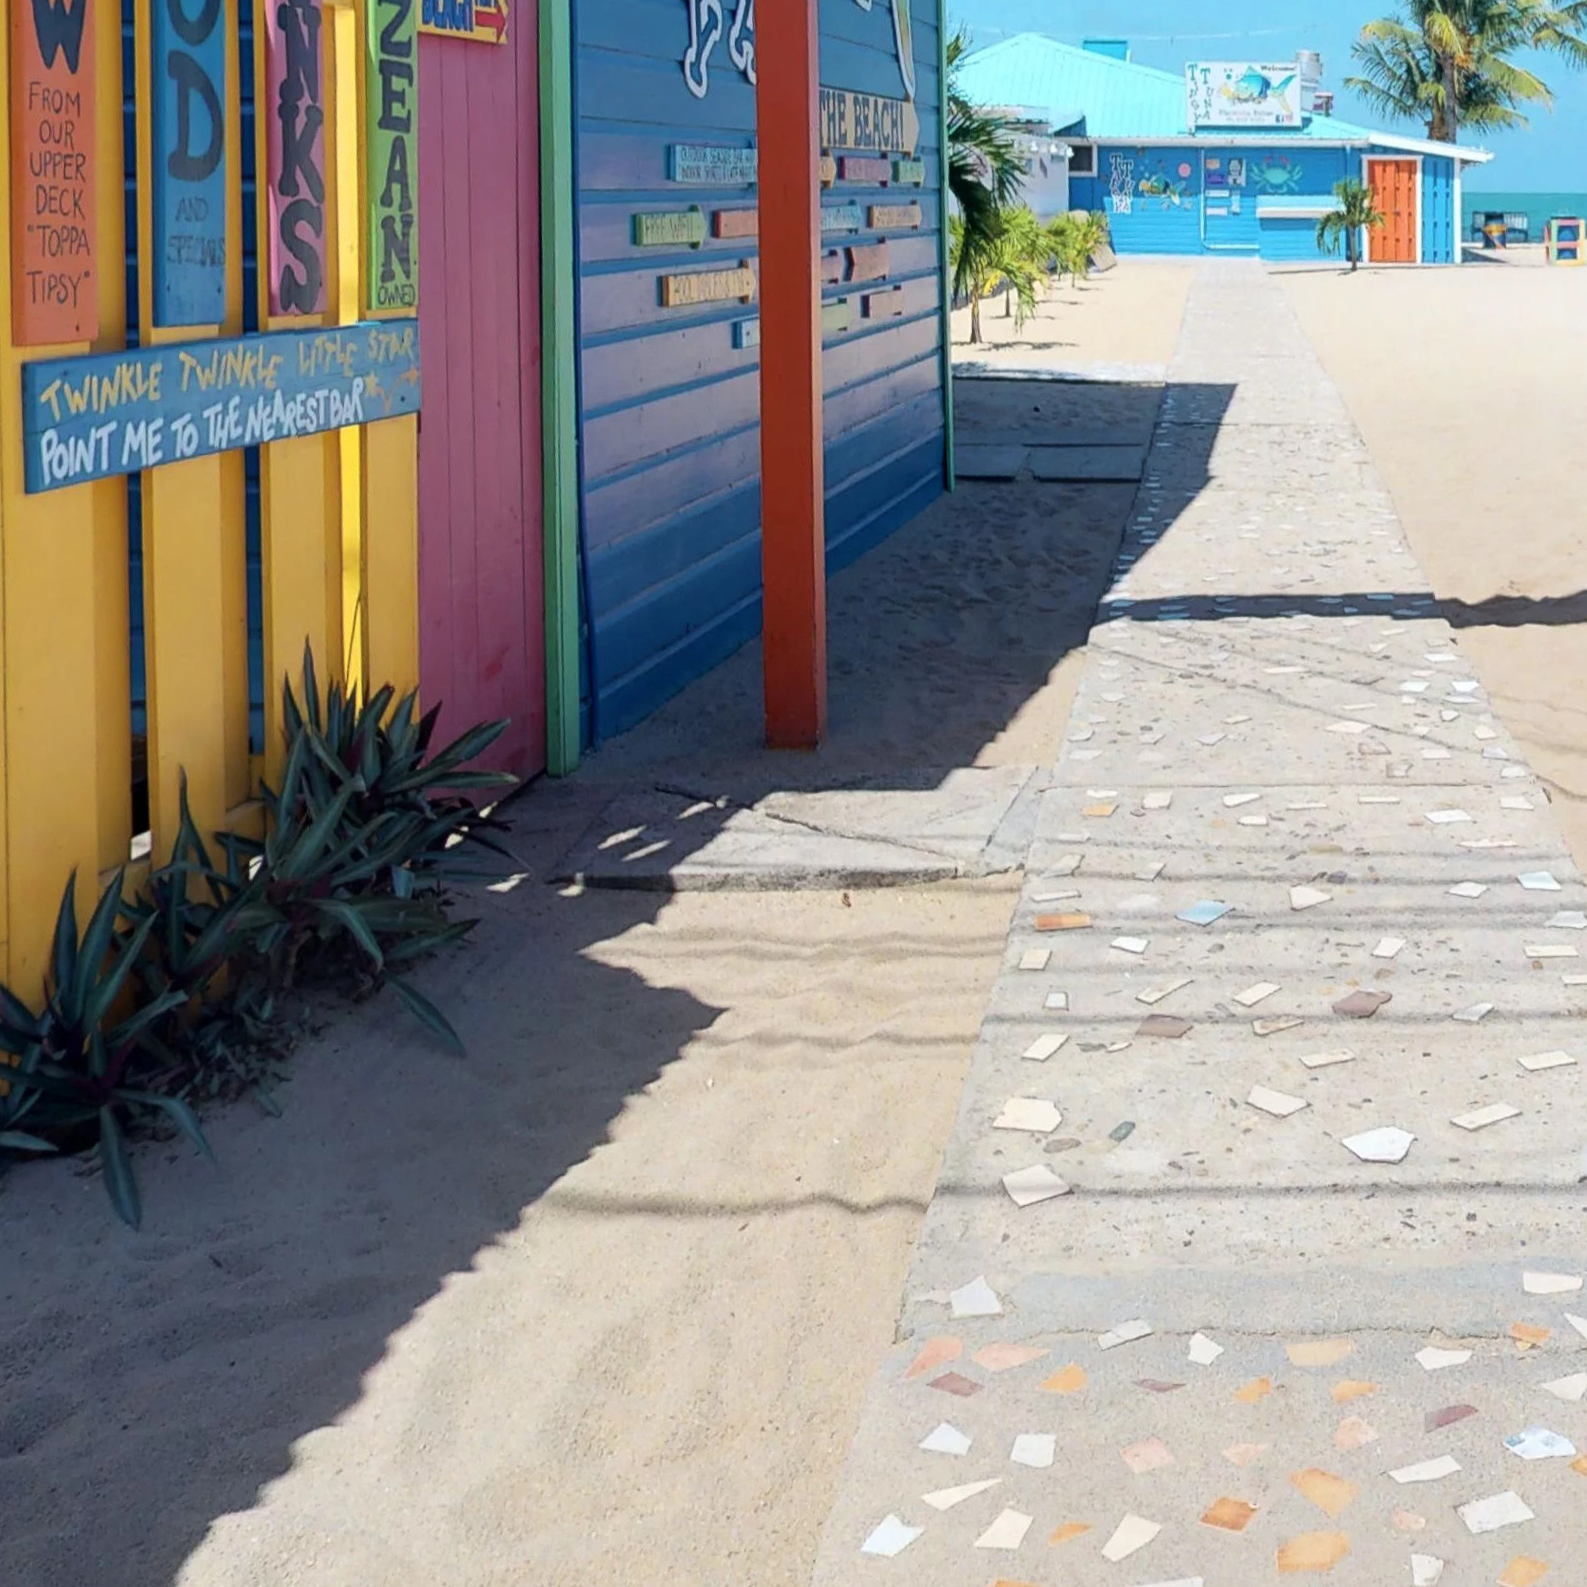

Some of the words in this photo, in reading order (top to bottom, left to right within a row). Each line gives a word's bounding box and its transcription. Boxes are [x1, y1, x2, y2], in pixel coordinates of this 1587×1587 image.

[28, 81, 82, 118] FROM
[38, 120, 76, 151] OUR
[820, 88, 849, 147] THE
[853, 96, 906, 150] BEACH!
[29, 151, 87, 184] UPPER
[35, 185, 85, 217] DECK
[174, 195, 210, 223] AND
[376, 283, 416, 306] OWNED
[40, 362, 163, 422] TWINKLE
[178, 344, 285, 392] TWINKLE
[298, 333, 358, 378] LITTLE
[367, 327, 414, 364] STAR
[40, 421, 118, 486] POINT
[121, 417, 164, 467] ME
[170, 413, 199, 457] TO
[202, 395, 243, 449] THE
